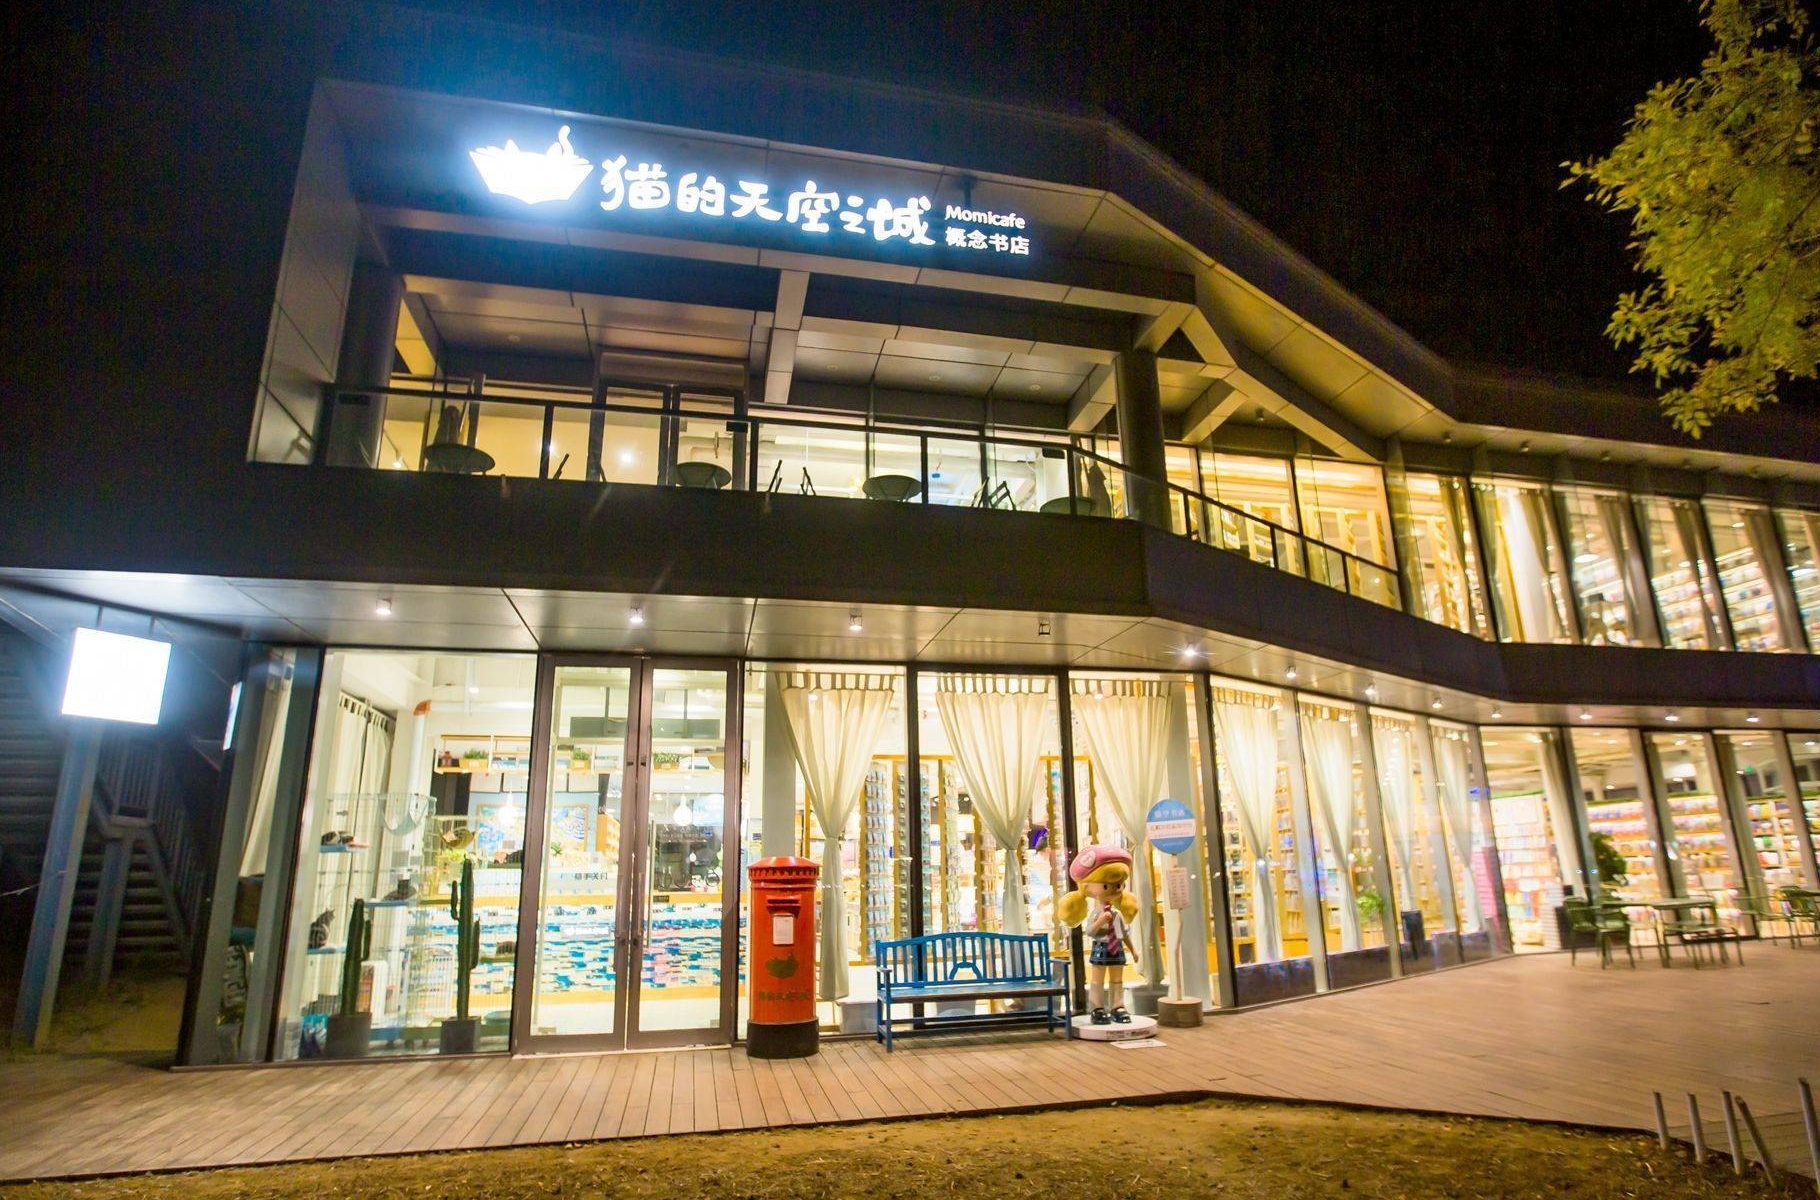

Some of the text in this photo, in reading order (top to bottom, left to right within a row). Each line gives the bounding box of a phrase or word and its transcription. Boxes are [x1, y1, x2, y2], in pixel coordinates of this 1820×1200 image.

[600, 154, 936, 246] 猫的天空之城
[945, 205, 1026, 229] Momicafe
[945, 226, 1030, 256] 概念书店
